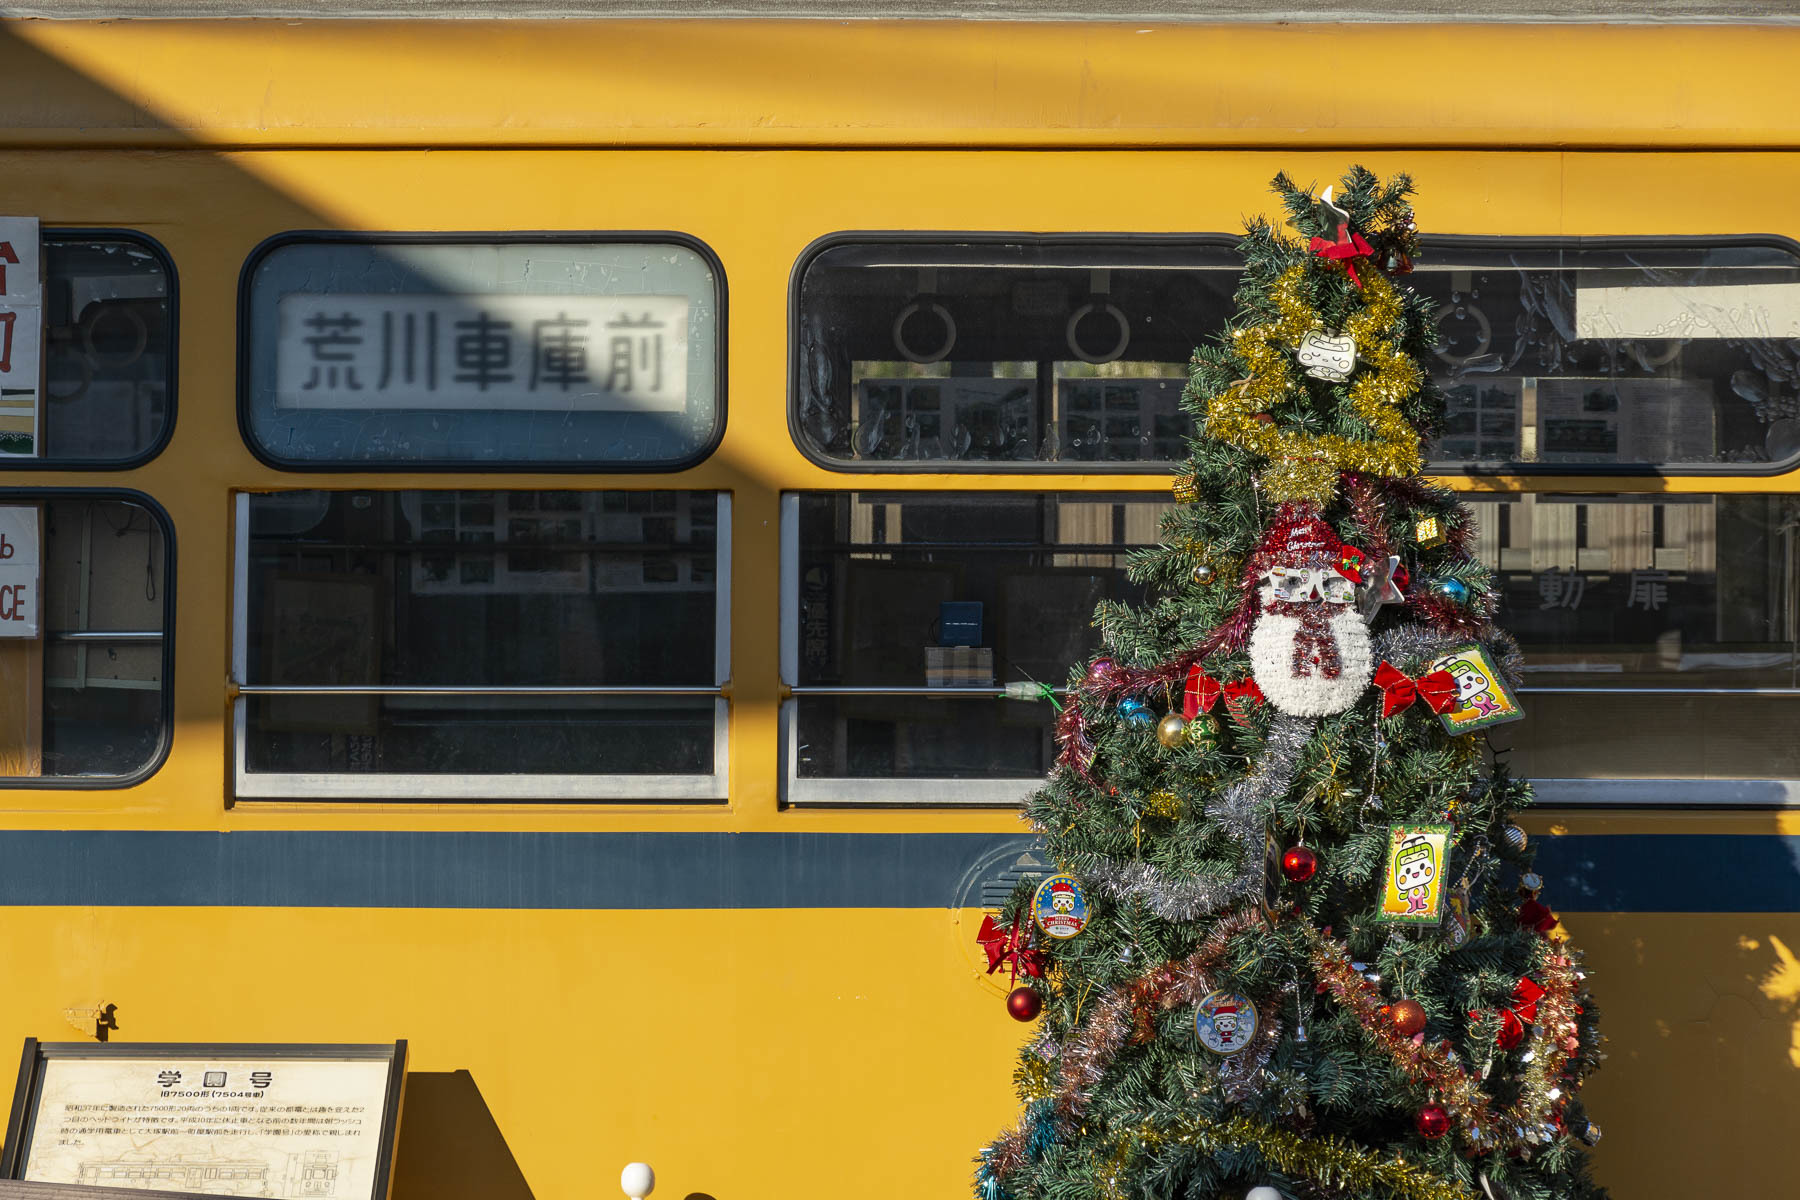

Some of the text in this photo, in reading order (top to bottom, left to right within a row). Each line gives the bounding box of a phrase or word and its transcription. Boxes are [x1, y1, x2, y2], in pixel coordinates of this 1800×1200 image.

[302, 311, 666, 393] 荒川車庫前
